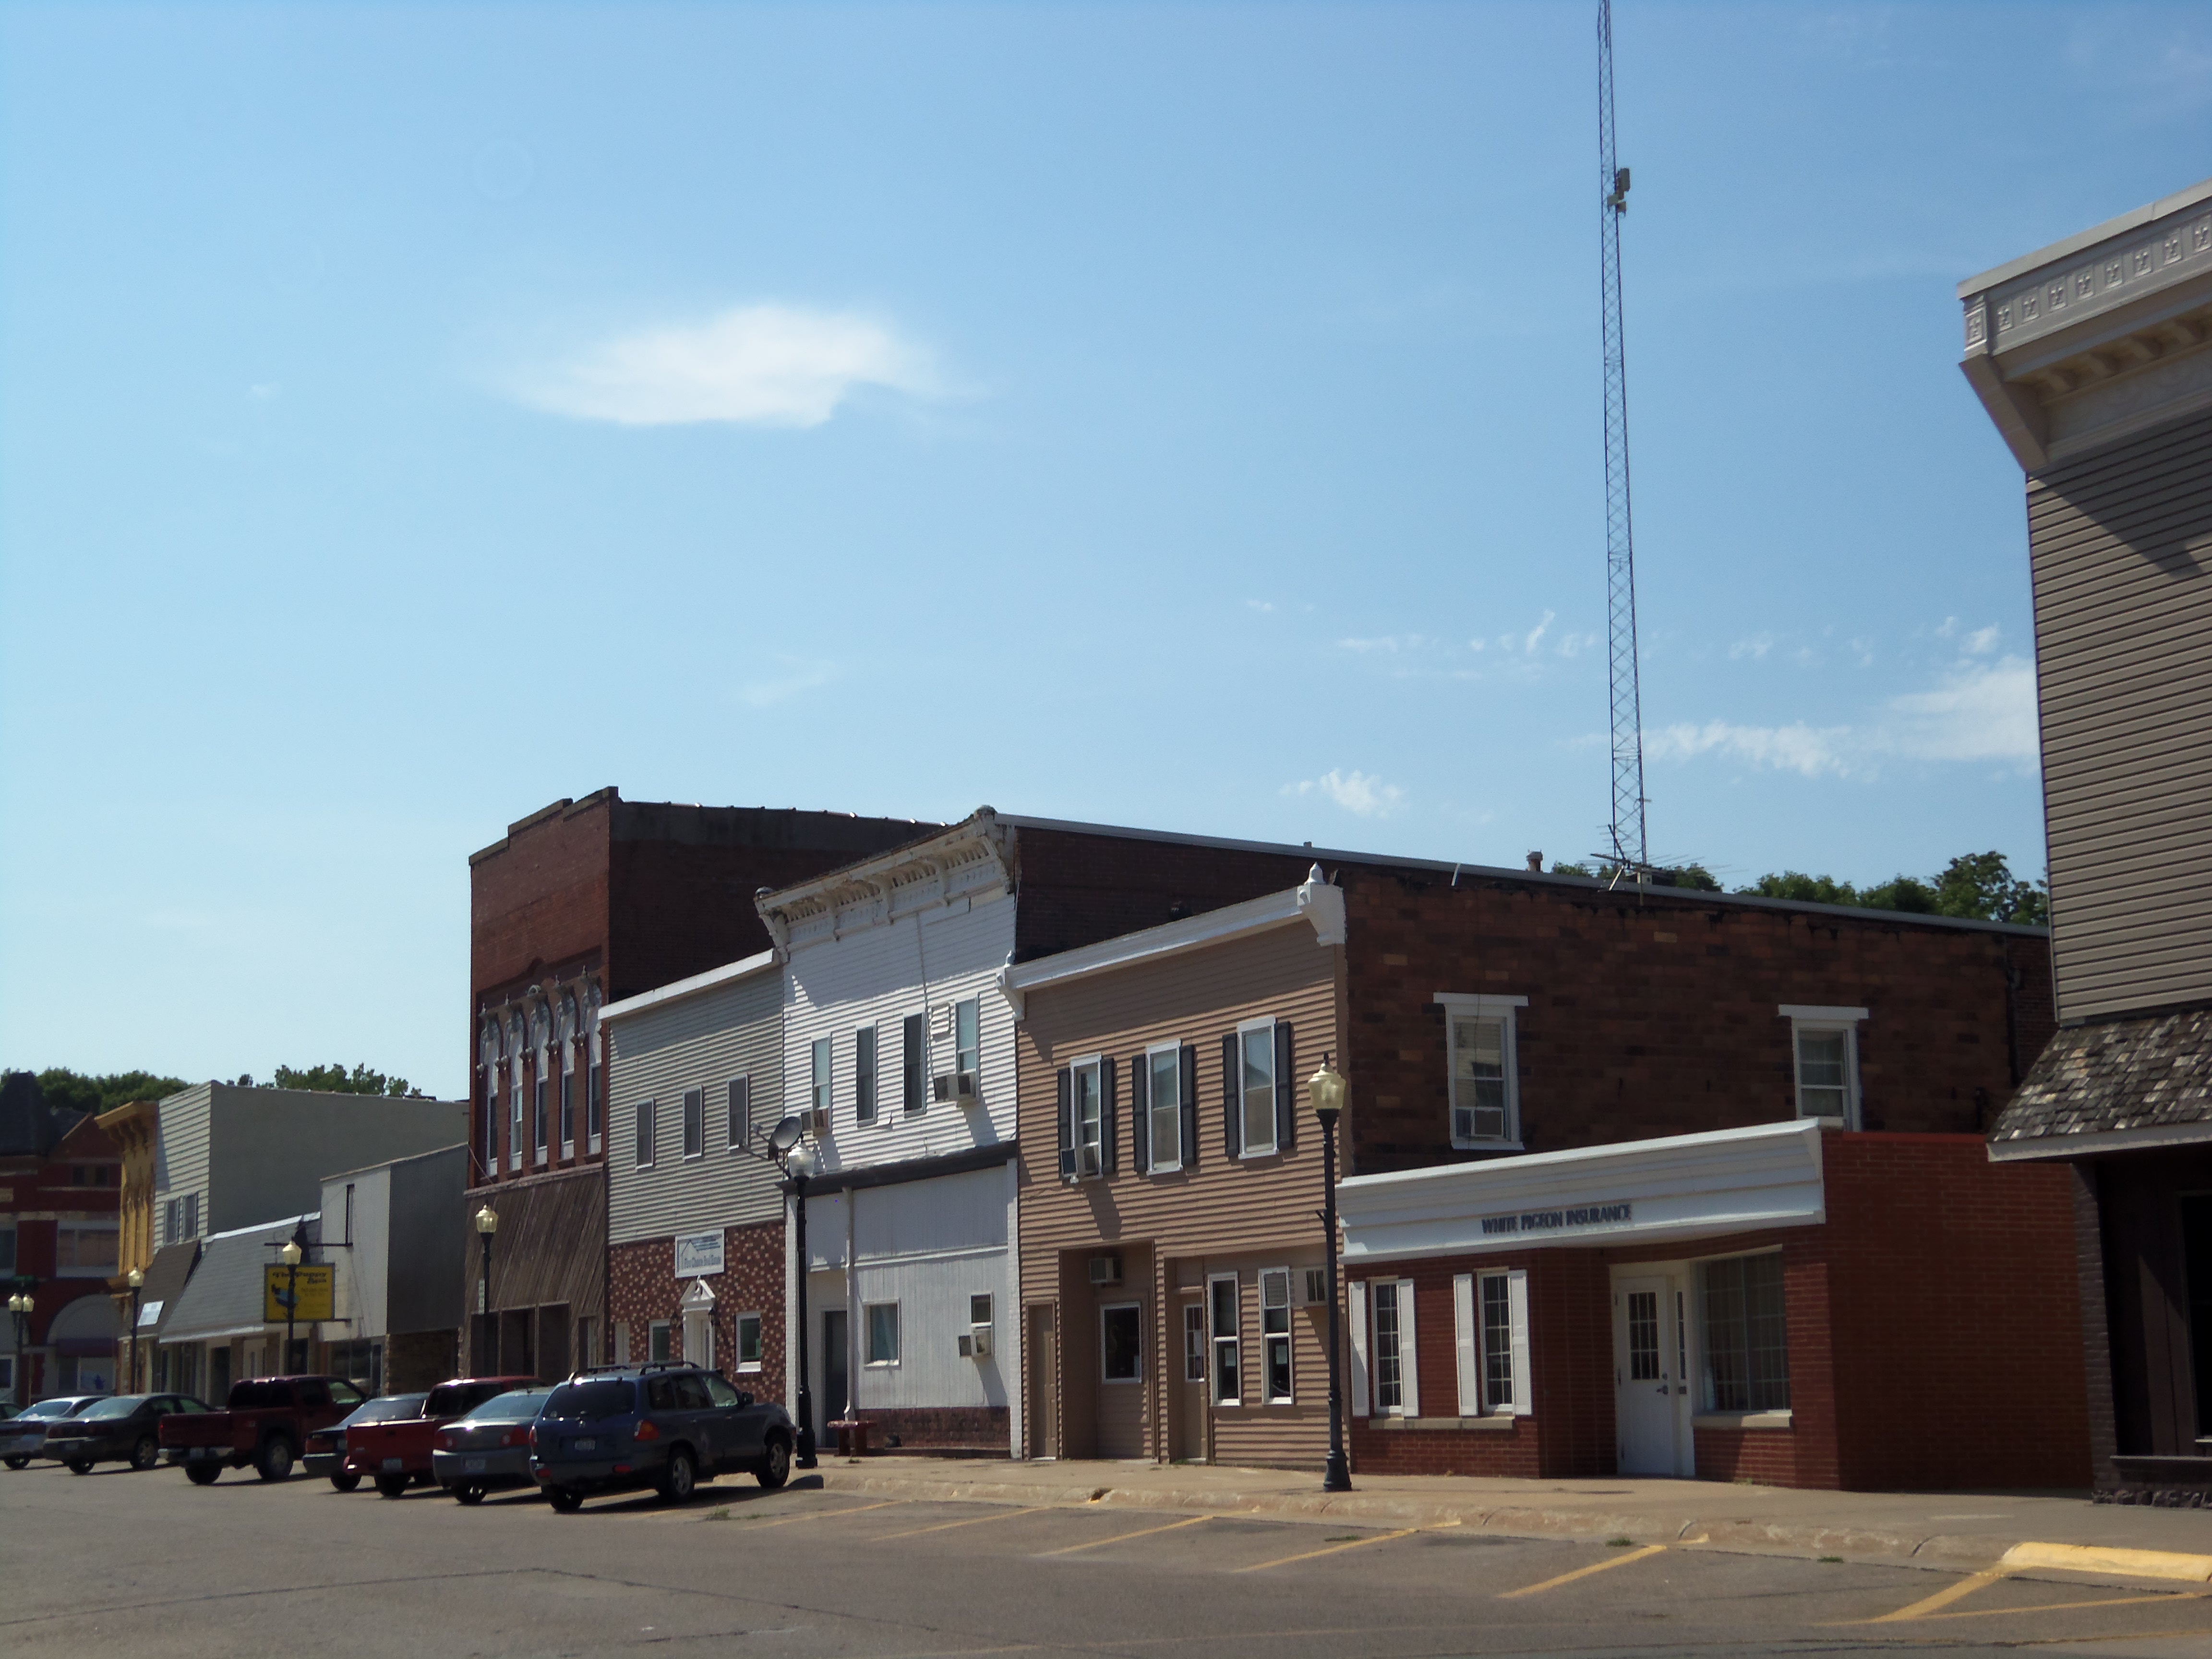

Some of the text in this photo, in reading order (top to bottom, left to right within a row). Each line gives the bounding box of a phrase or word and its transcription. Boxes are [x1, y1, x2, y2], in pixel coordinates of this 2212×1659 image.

[1482, 1203, 1631, 1234] WHITE PIGEON INSURANCE
